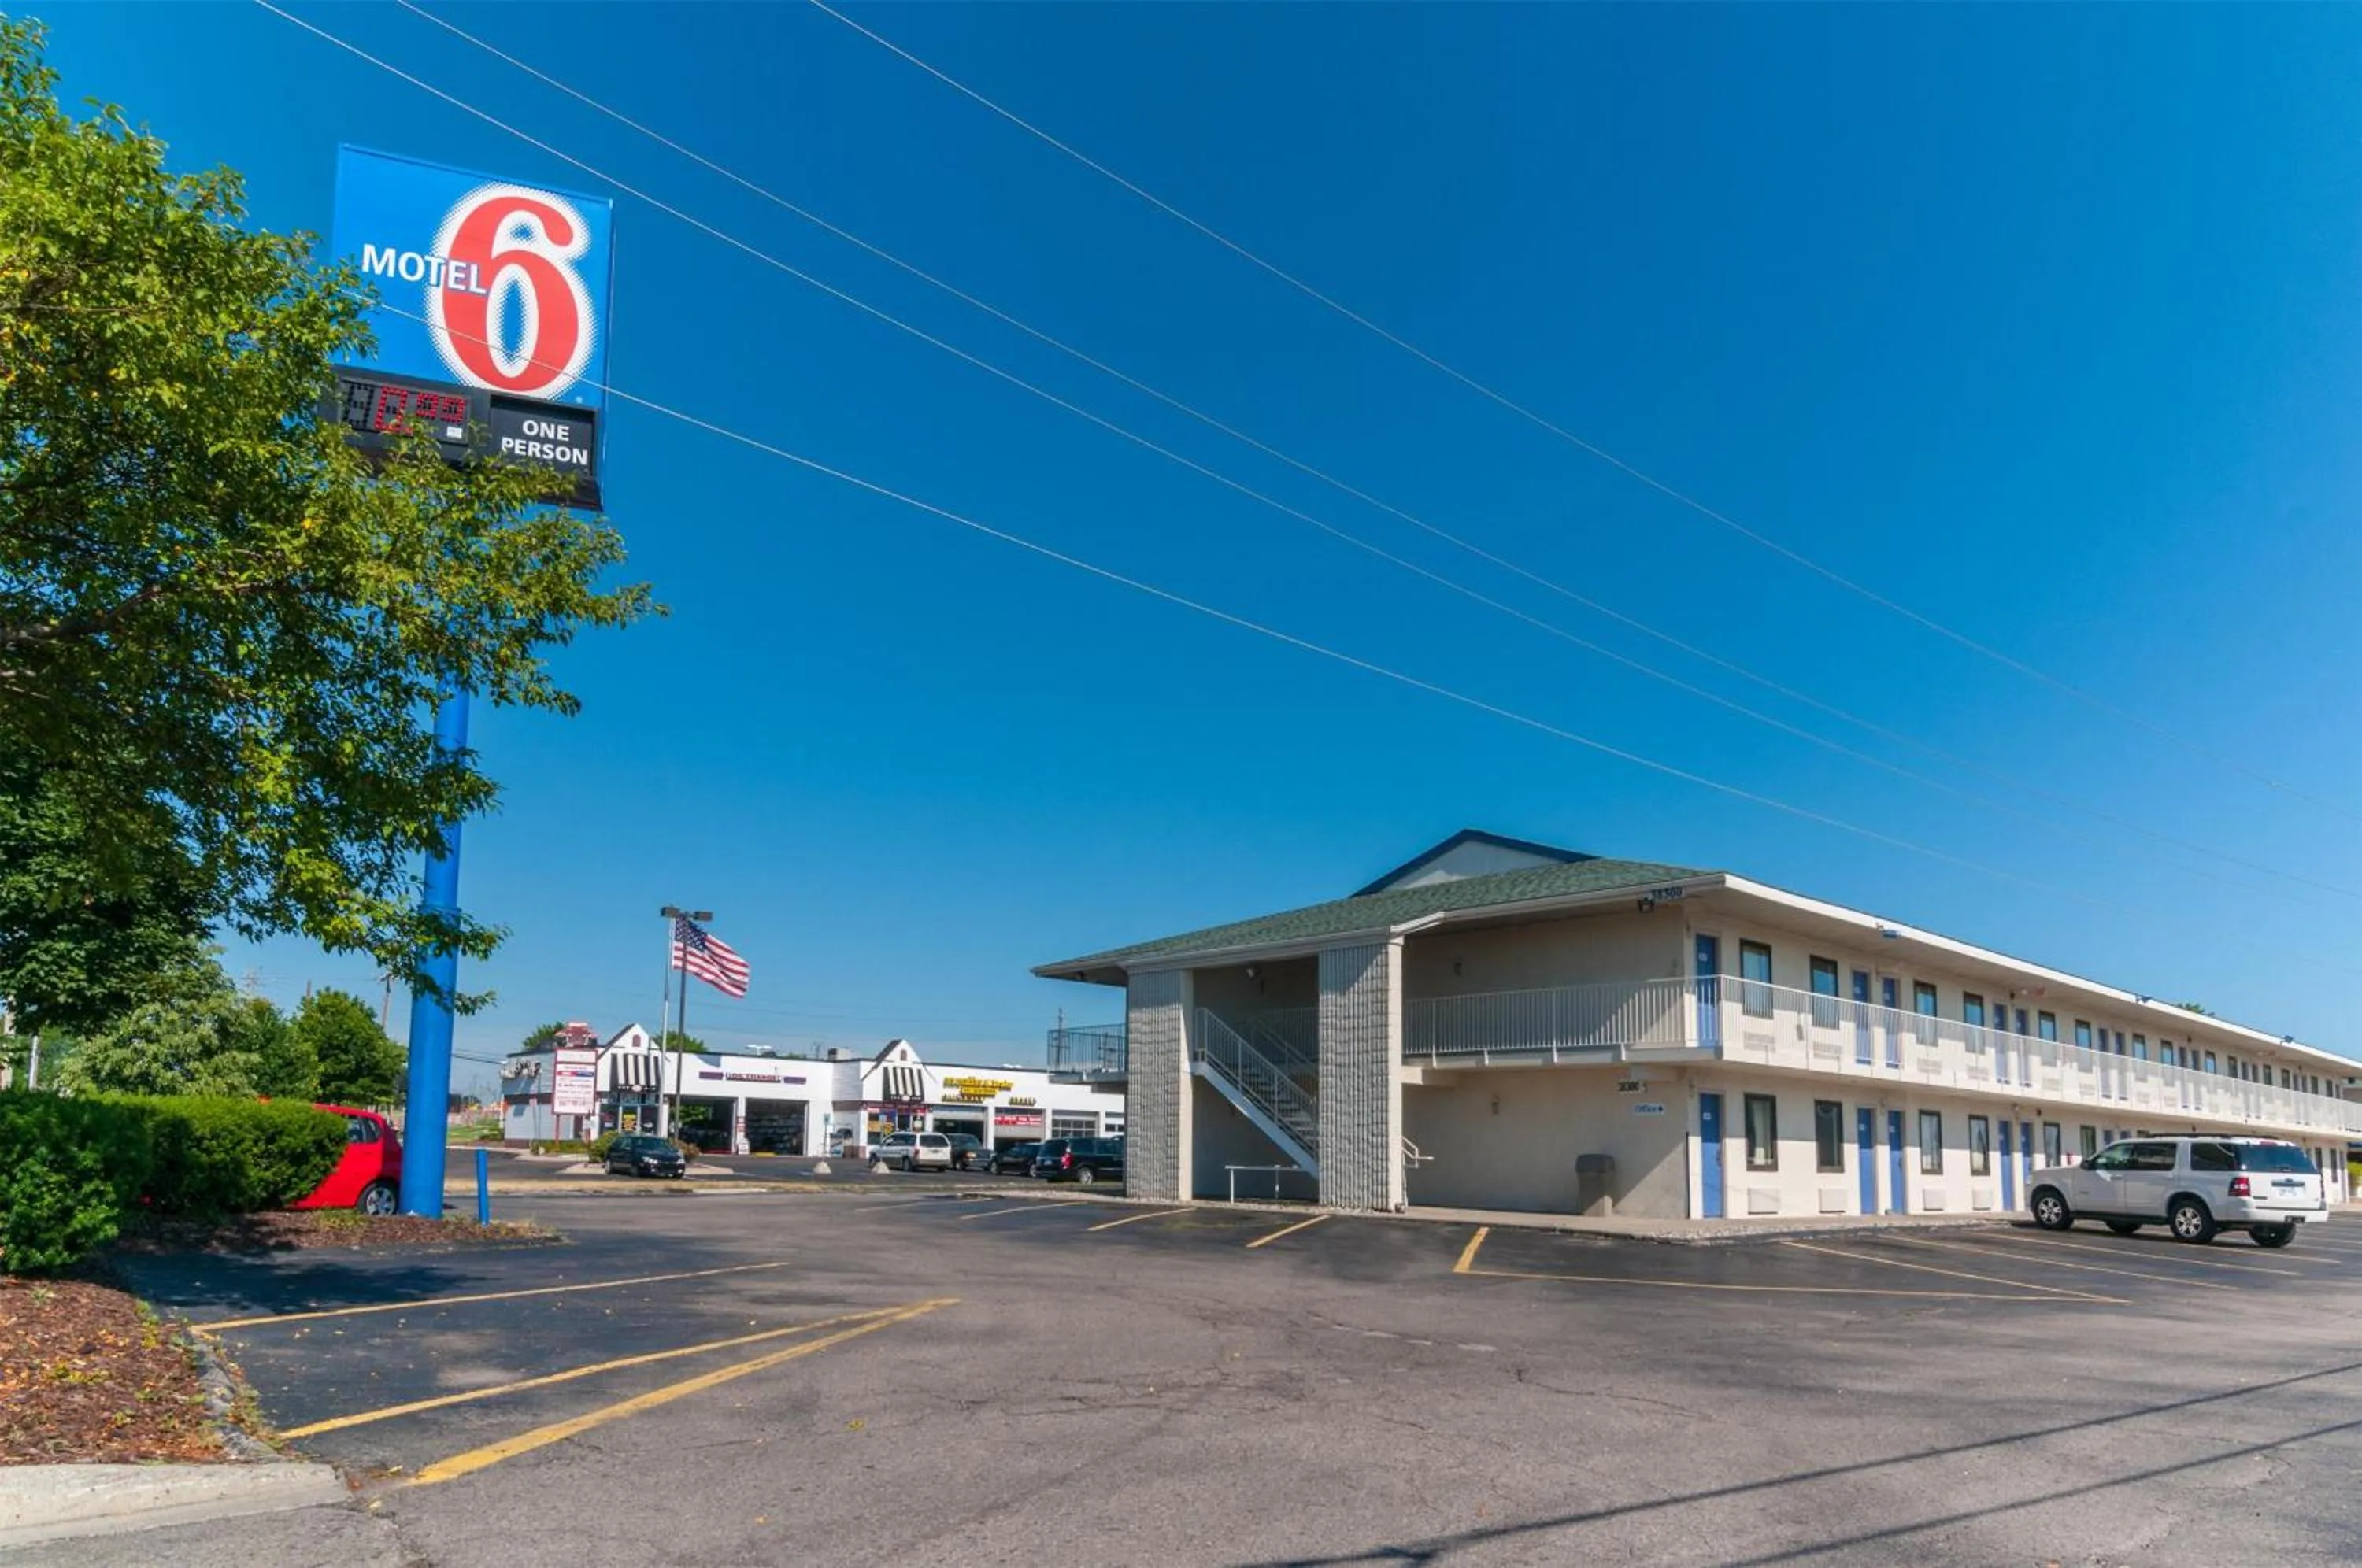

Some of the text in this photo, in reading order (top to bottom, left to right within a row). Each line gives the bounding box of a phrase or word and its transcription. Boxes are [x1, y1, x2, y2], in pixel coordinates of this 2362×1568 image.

[361, 192, 583, 394] MOTEL 6
[522, 420, 570, 442] ONE
[501, 437, 588, 465] PERSON
